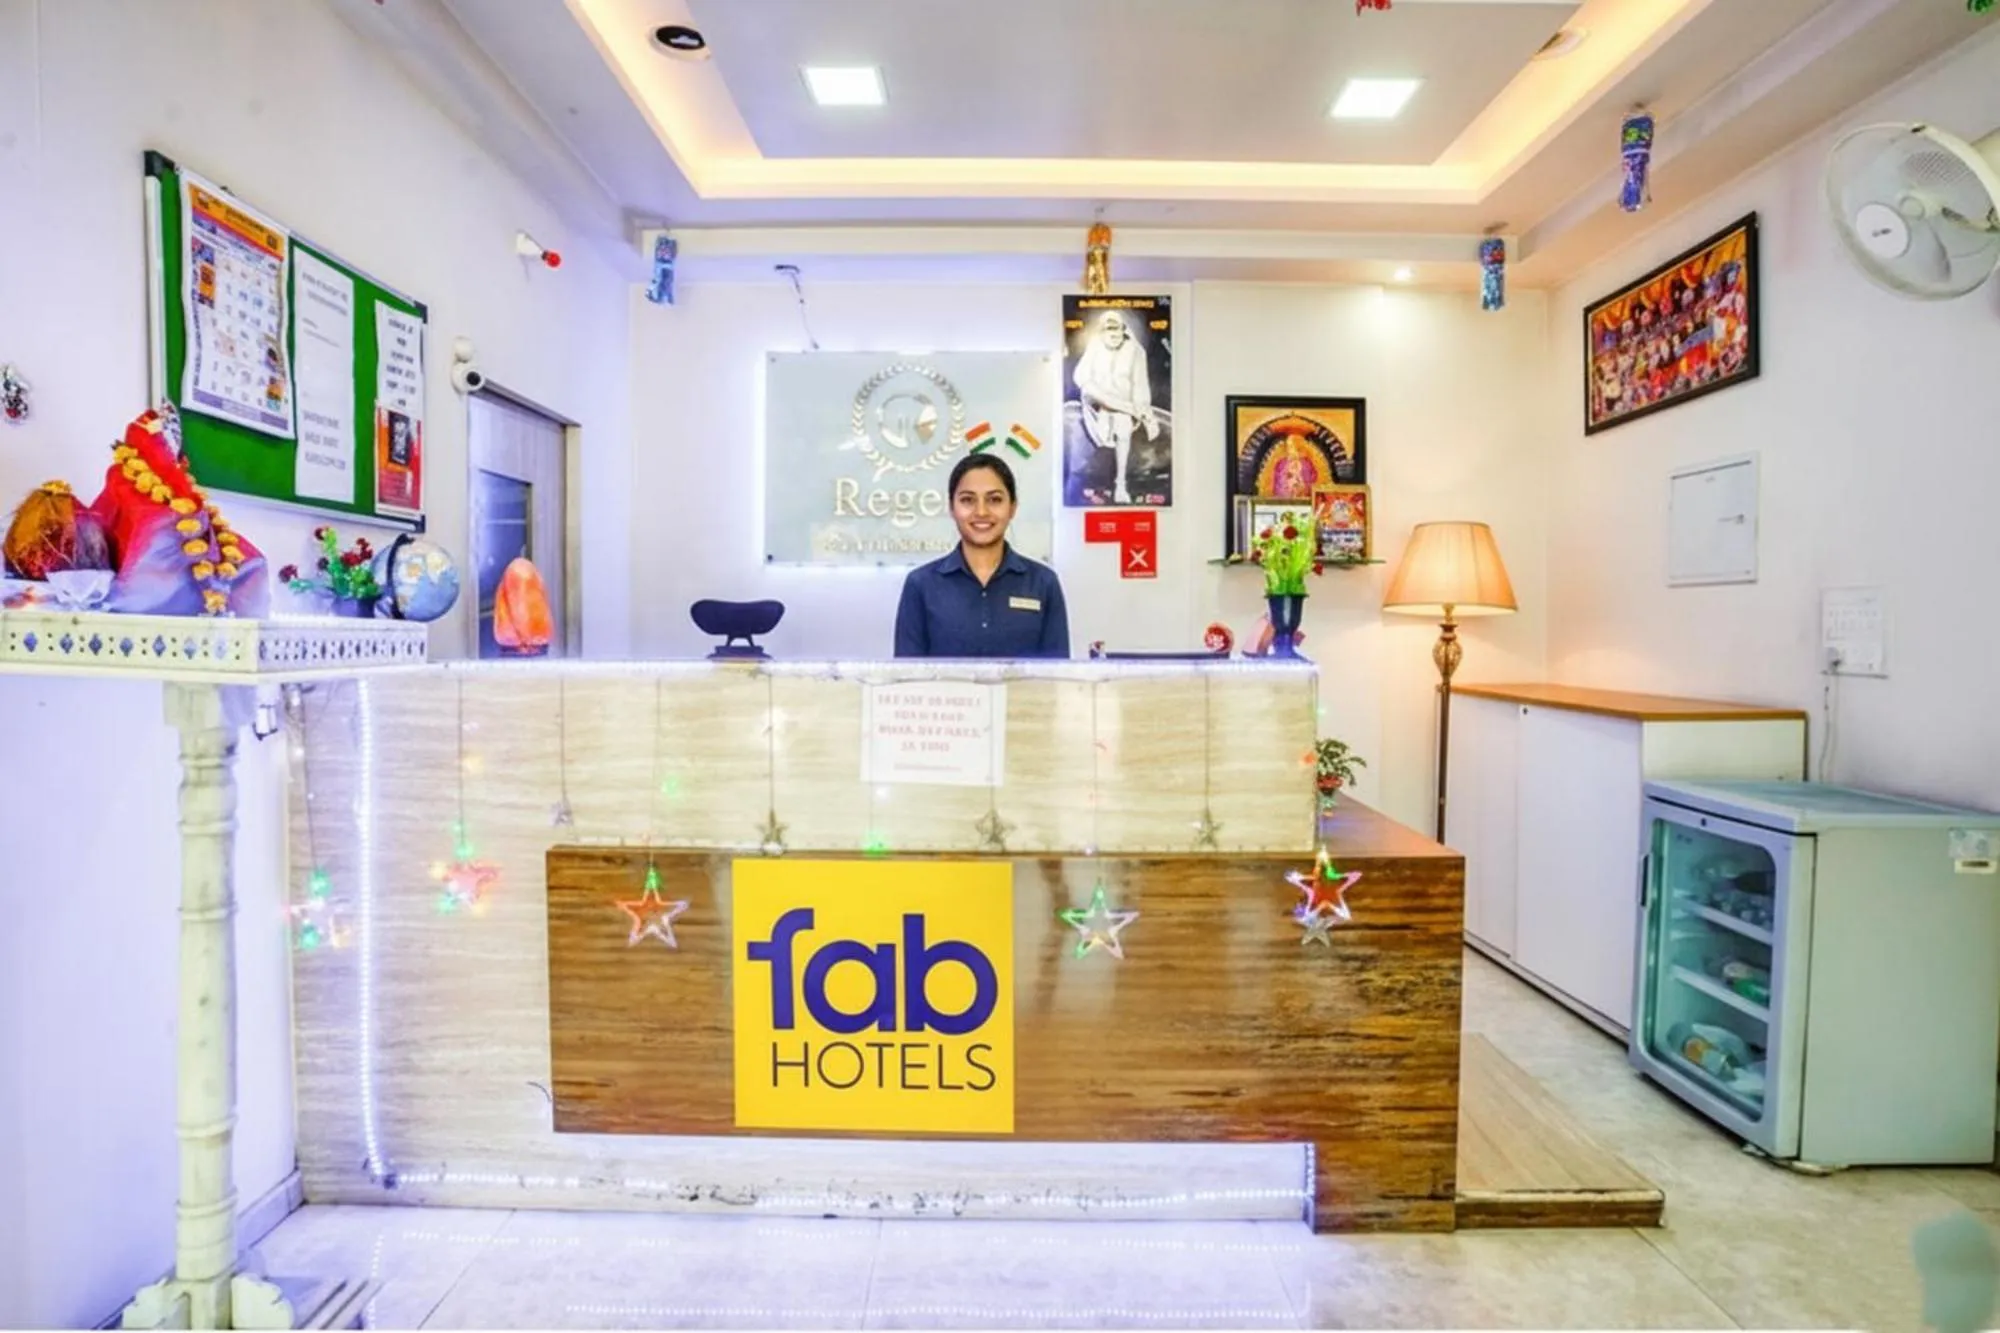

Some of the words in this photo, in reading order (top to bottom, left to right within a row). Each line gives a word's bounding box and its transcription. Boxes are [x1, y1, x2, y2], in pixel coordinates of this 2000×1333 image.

[834, 477, 950, 528] Rege
[747, 907, 998, 1035] fab
[773, 1041, 996, 1092] HOTELS
